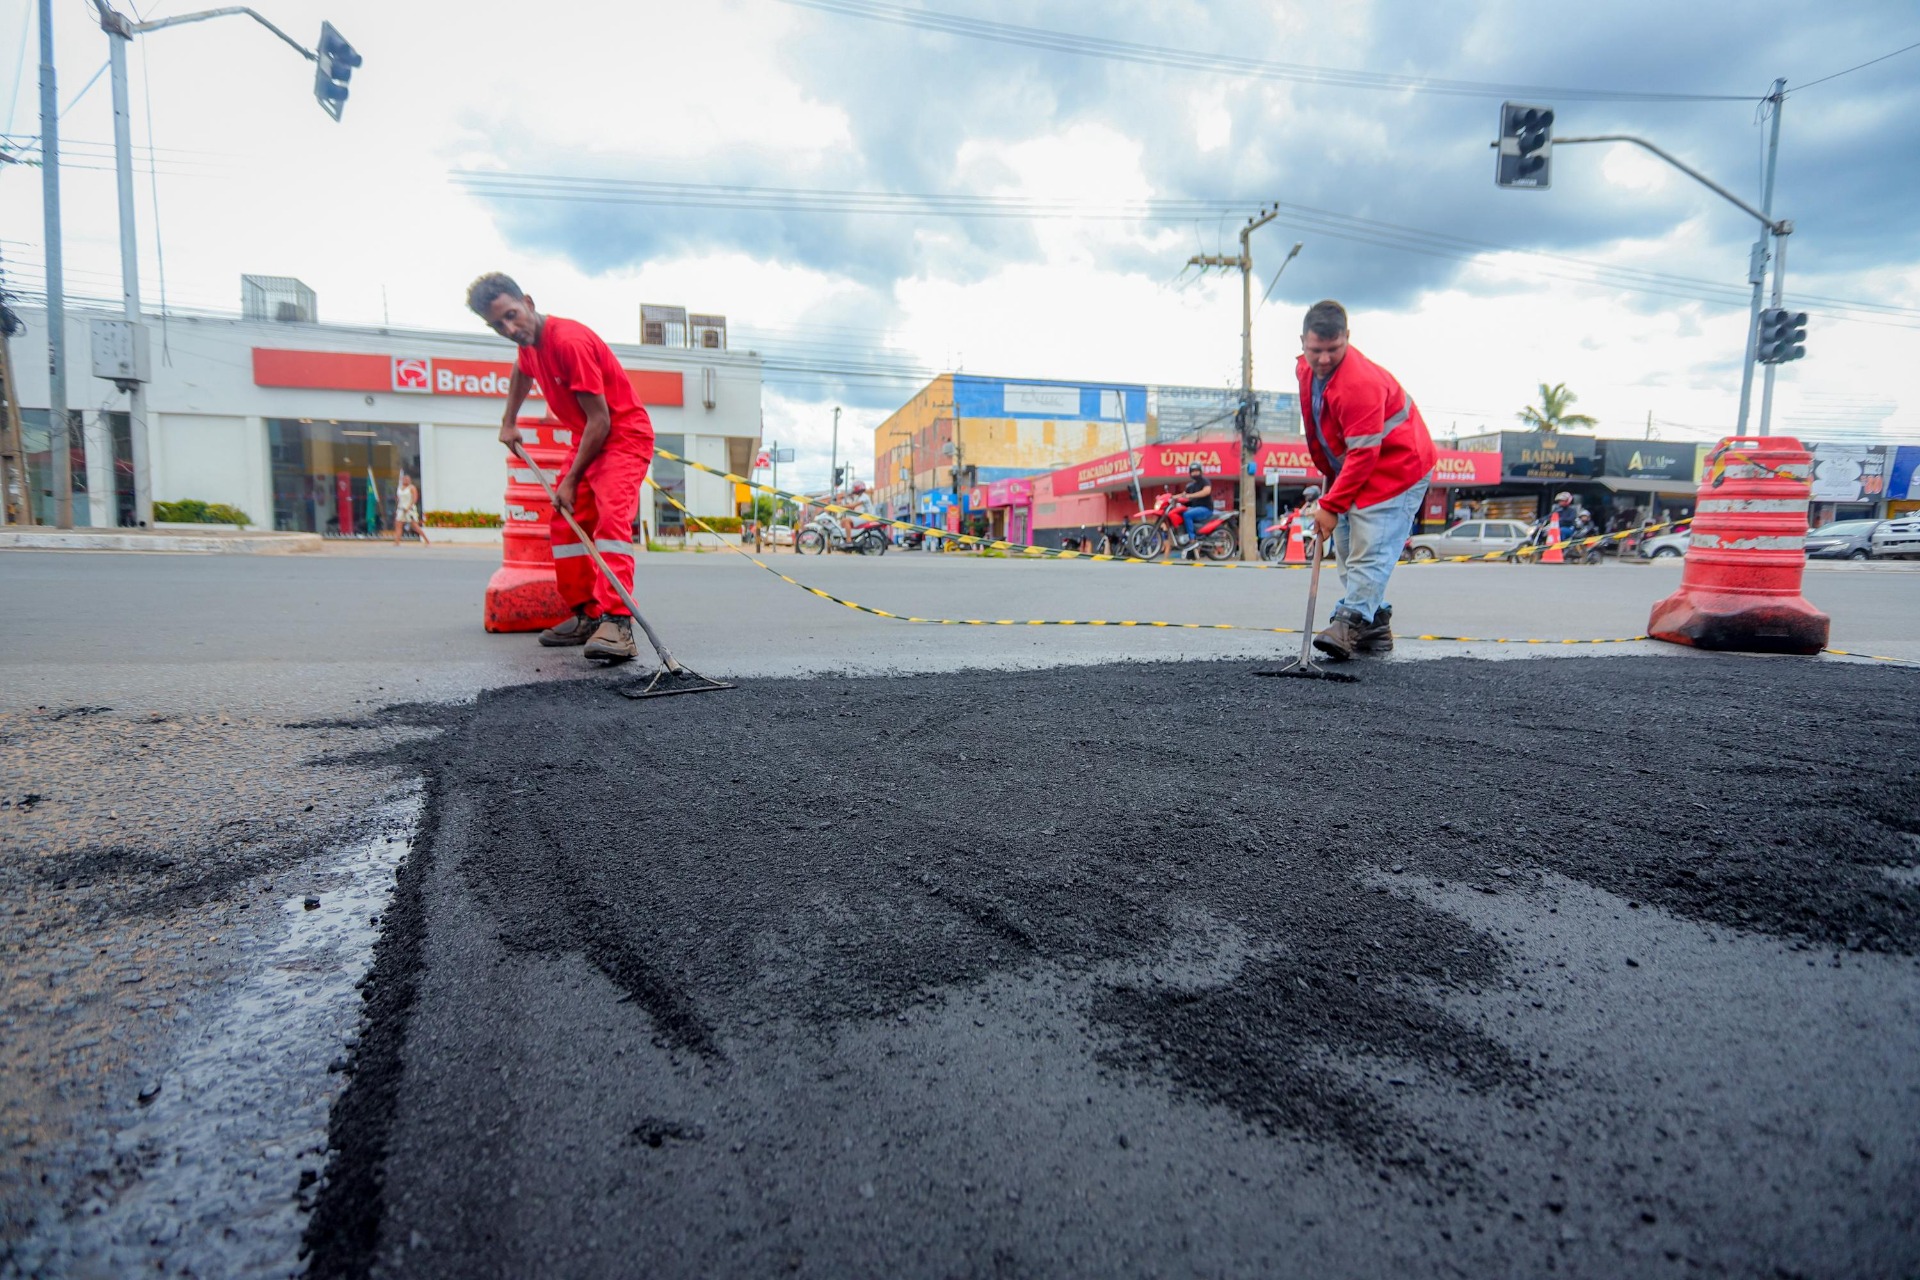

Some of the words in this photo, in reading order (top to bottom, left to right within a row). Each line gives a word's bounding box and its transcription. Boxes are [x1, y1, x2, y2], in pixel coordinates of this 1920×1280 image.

[436, 368, 543, 396] Brade
[1160, 449, 1222, 467] ÚNICA
[1265, 451, 1315, 467] ATAC
[1521, 449, 1574, 464] RAINHA
[1435, 458, 1475, 473] NICA
